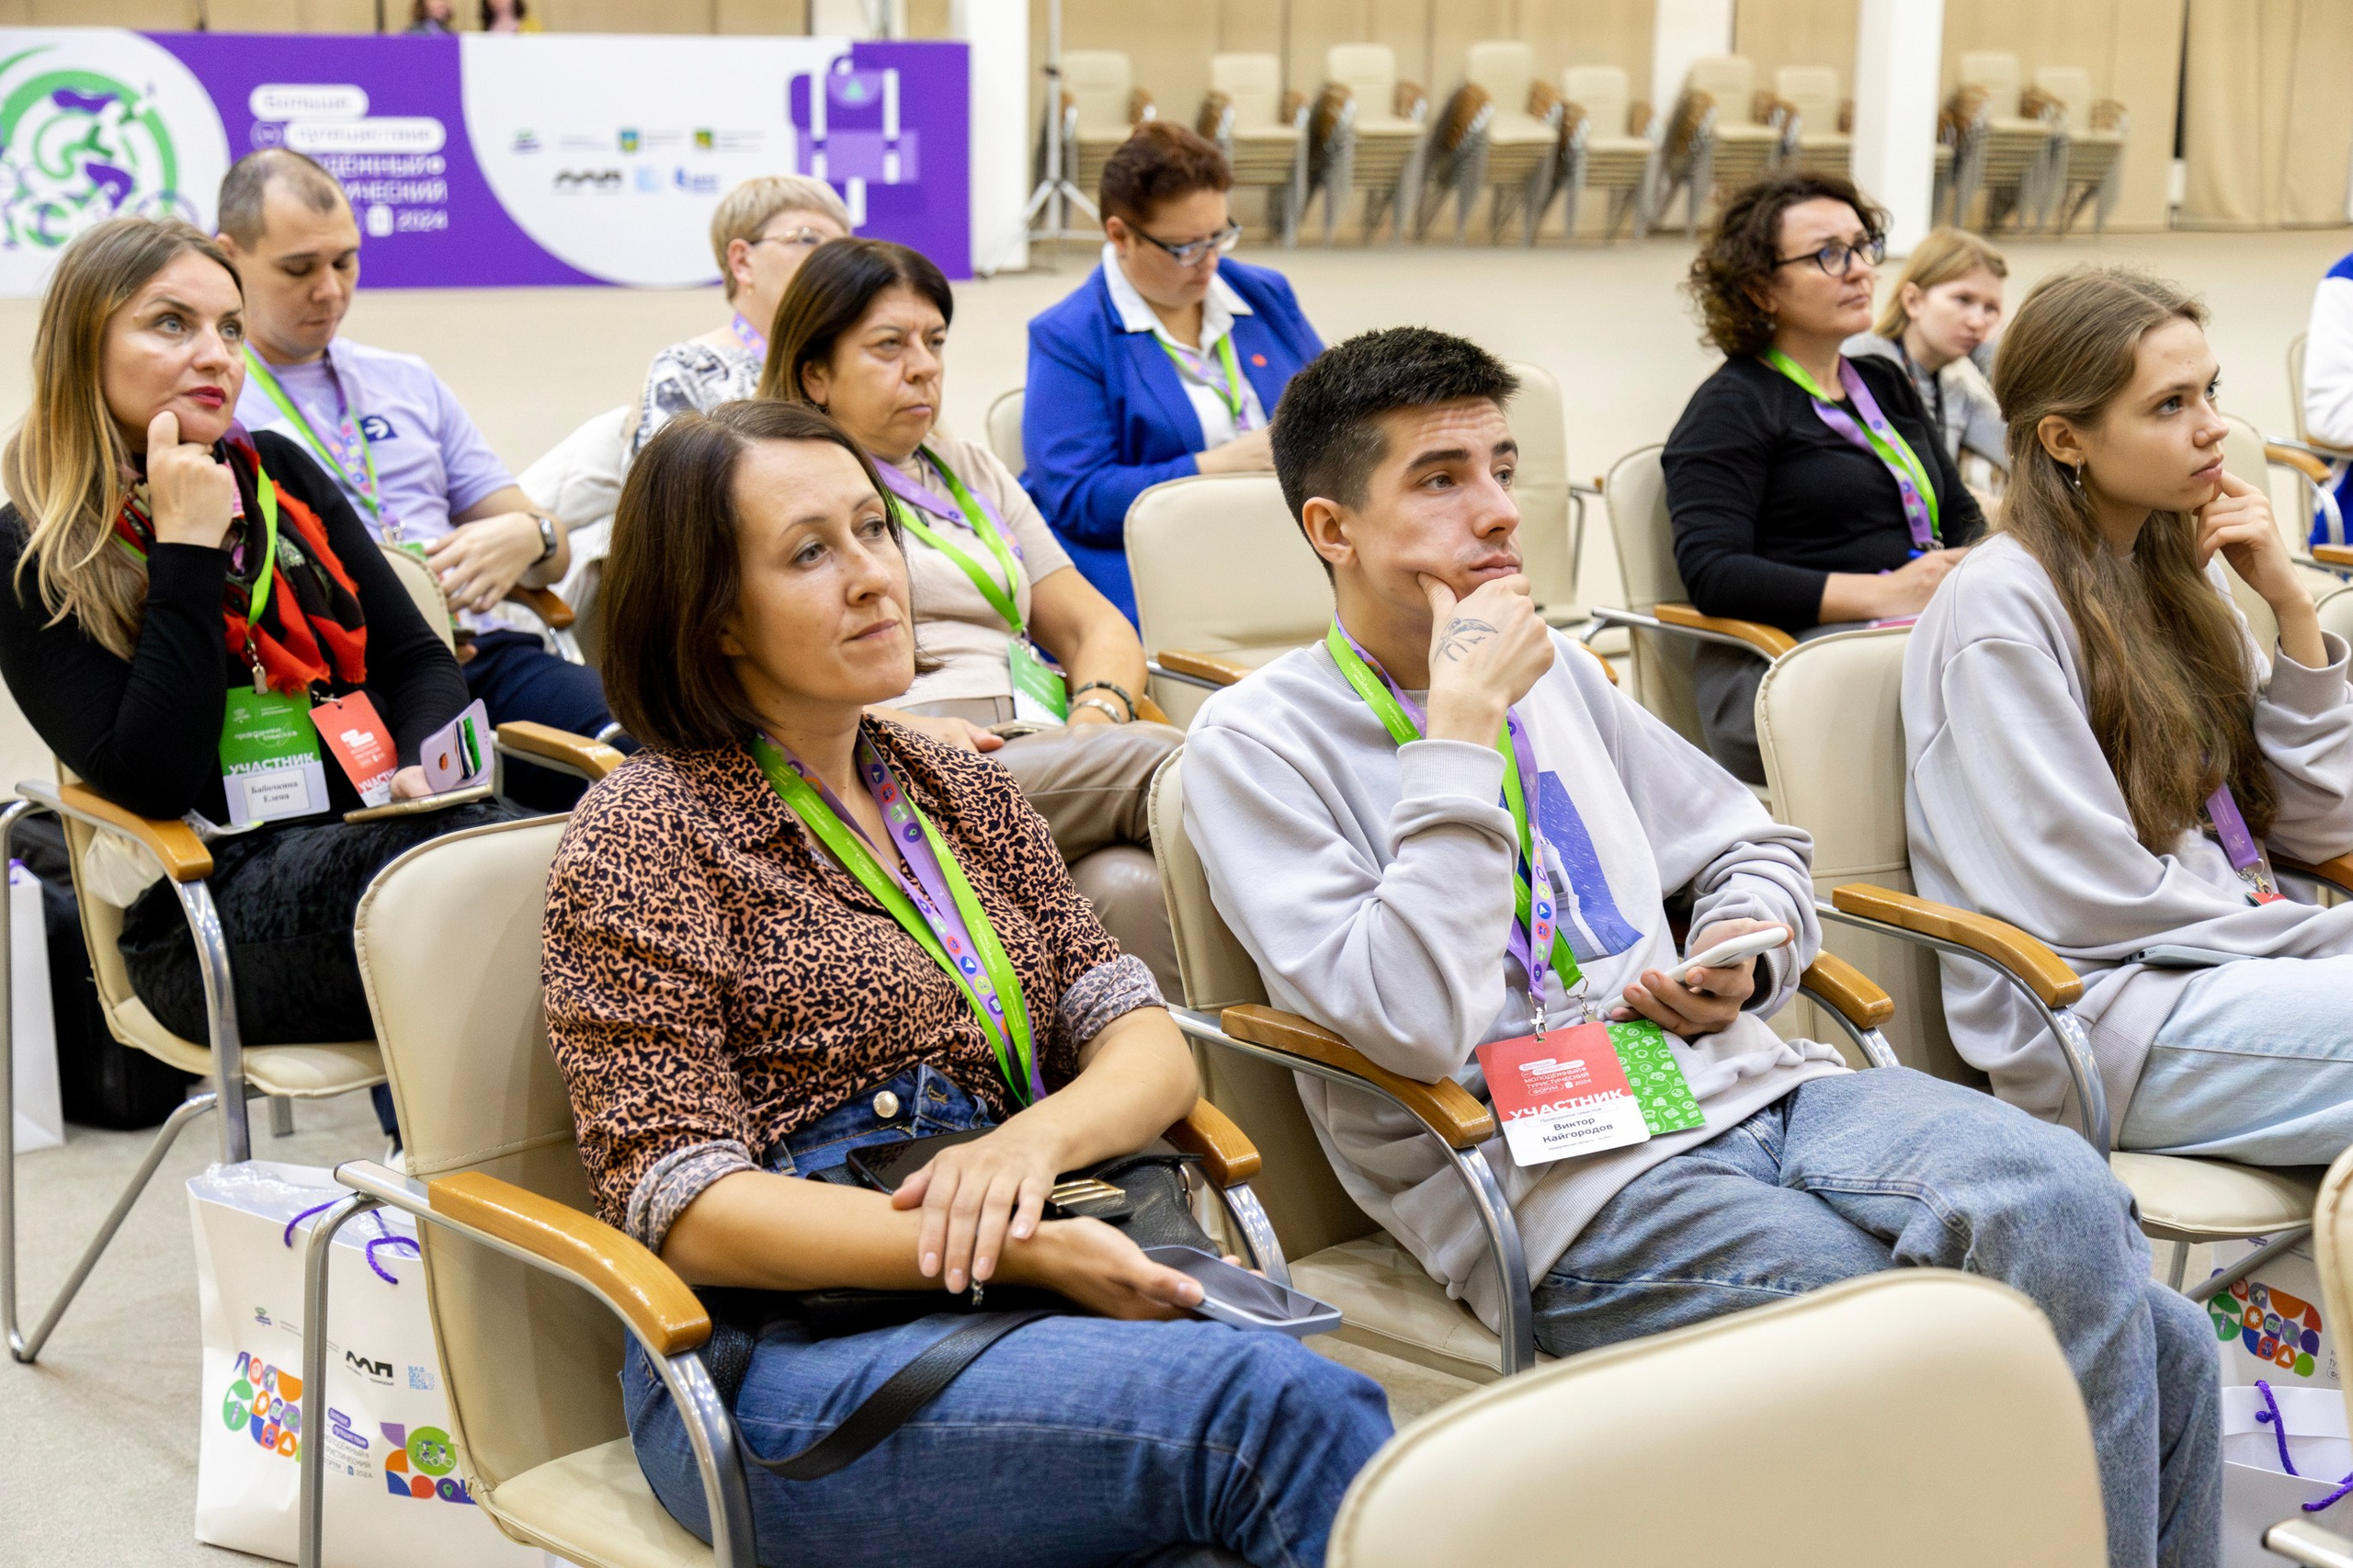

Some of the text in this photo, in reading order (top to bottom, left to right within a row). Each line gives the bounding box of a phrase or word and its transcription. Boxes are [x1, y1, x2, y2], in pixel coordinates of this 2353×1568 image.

[229, 752, 314, 776] УЧАСТНИК
[1527, 1072, 1590, 1088] ТУРИСТИЧЕСКИЙ
[1574, 1078, 1592, 1086] 2024
[1509, 1088, 1627, 1120] УЧАСТНИК
[1543, 1123, 1614, 1143] Кайгородов
[1553, 1118, 1596, 1131] Виктор
